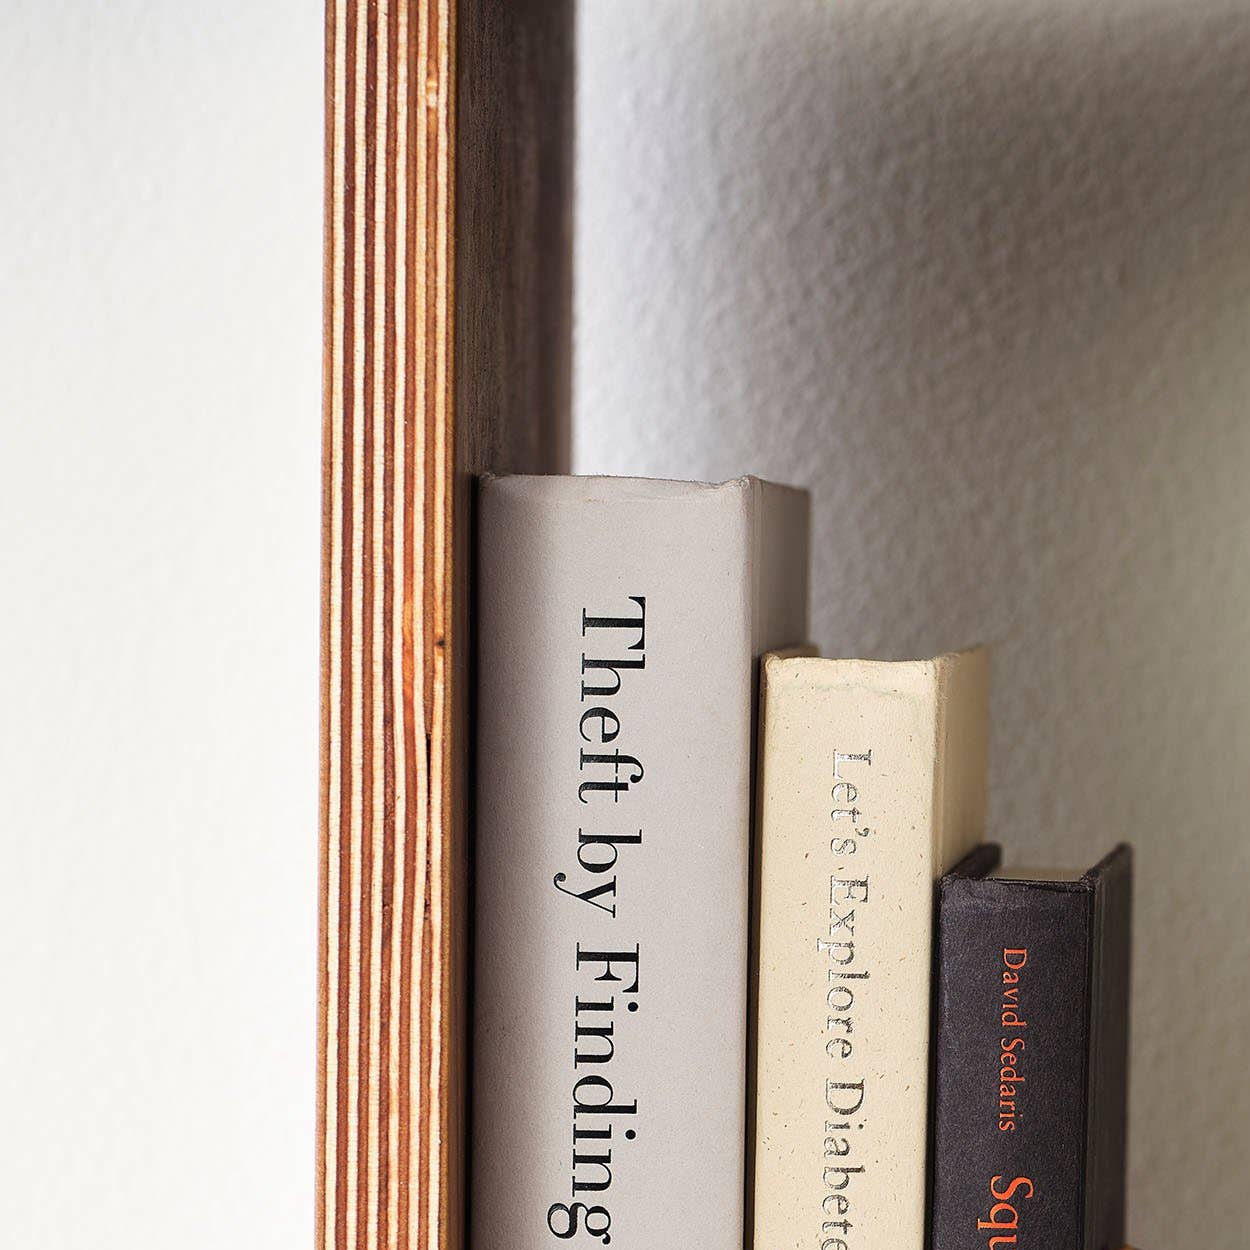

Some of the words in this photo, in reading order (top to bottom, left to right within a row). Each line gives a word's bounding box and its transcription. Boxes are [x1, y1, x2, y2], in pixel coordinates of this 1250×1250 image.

[579, 596, 645, 802] Theft
[830, 748, 873, 856] Let’s
[554, 828, 642, 918] by
[816, 874, 871, 1060] Explore
[1001, 949, 1027, 1026] David
[547, 942, 639, 1244] Finding
[998, 1038, 1024, 1131] Sedaris
